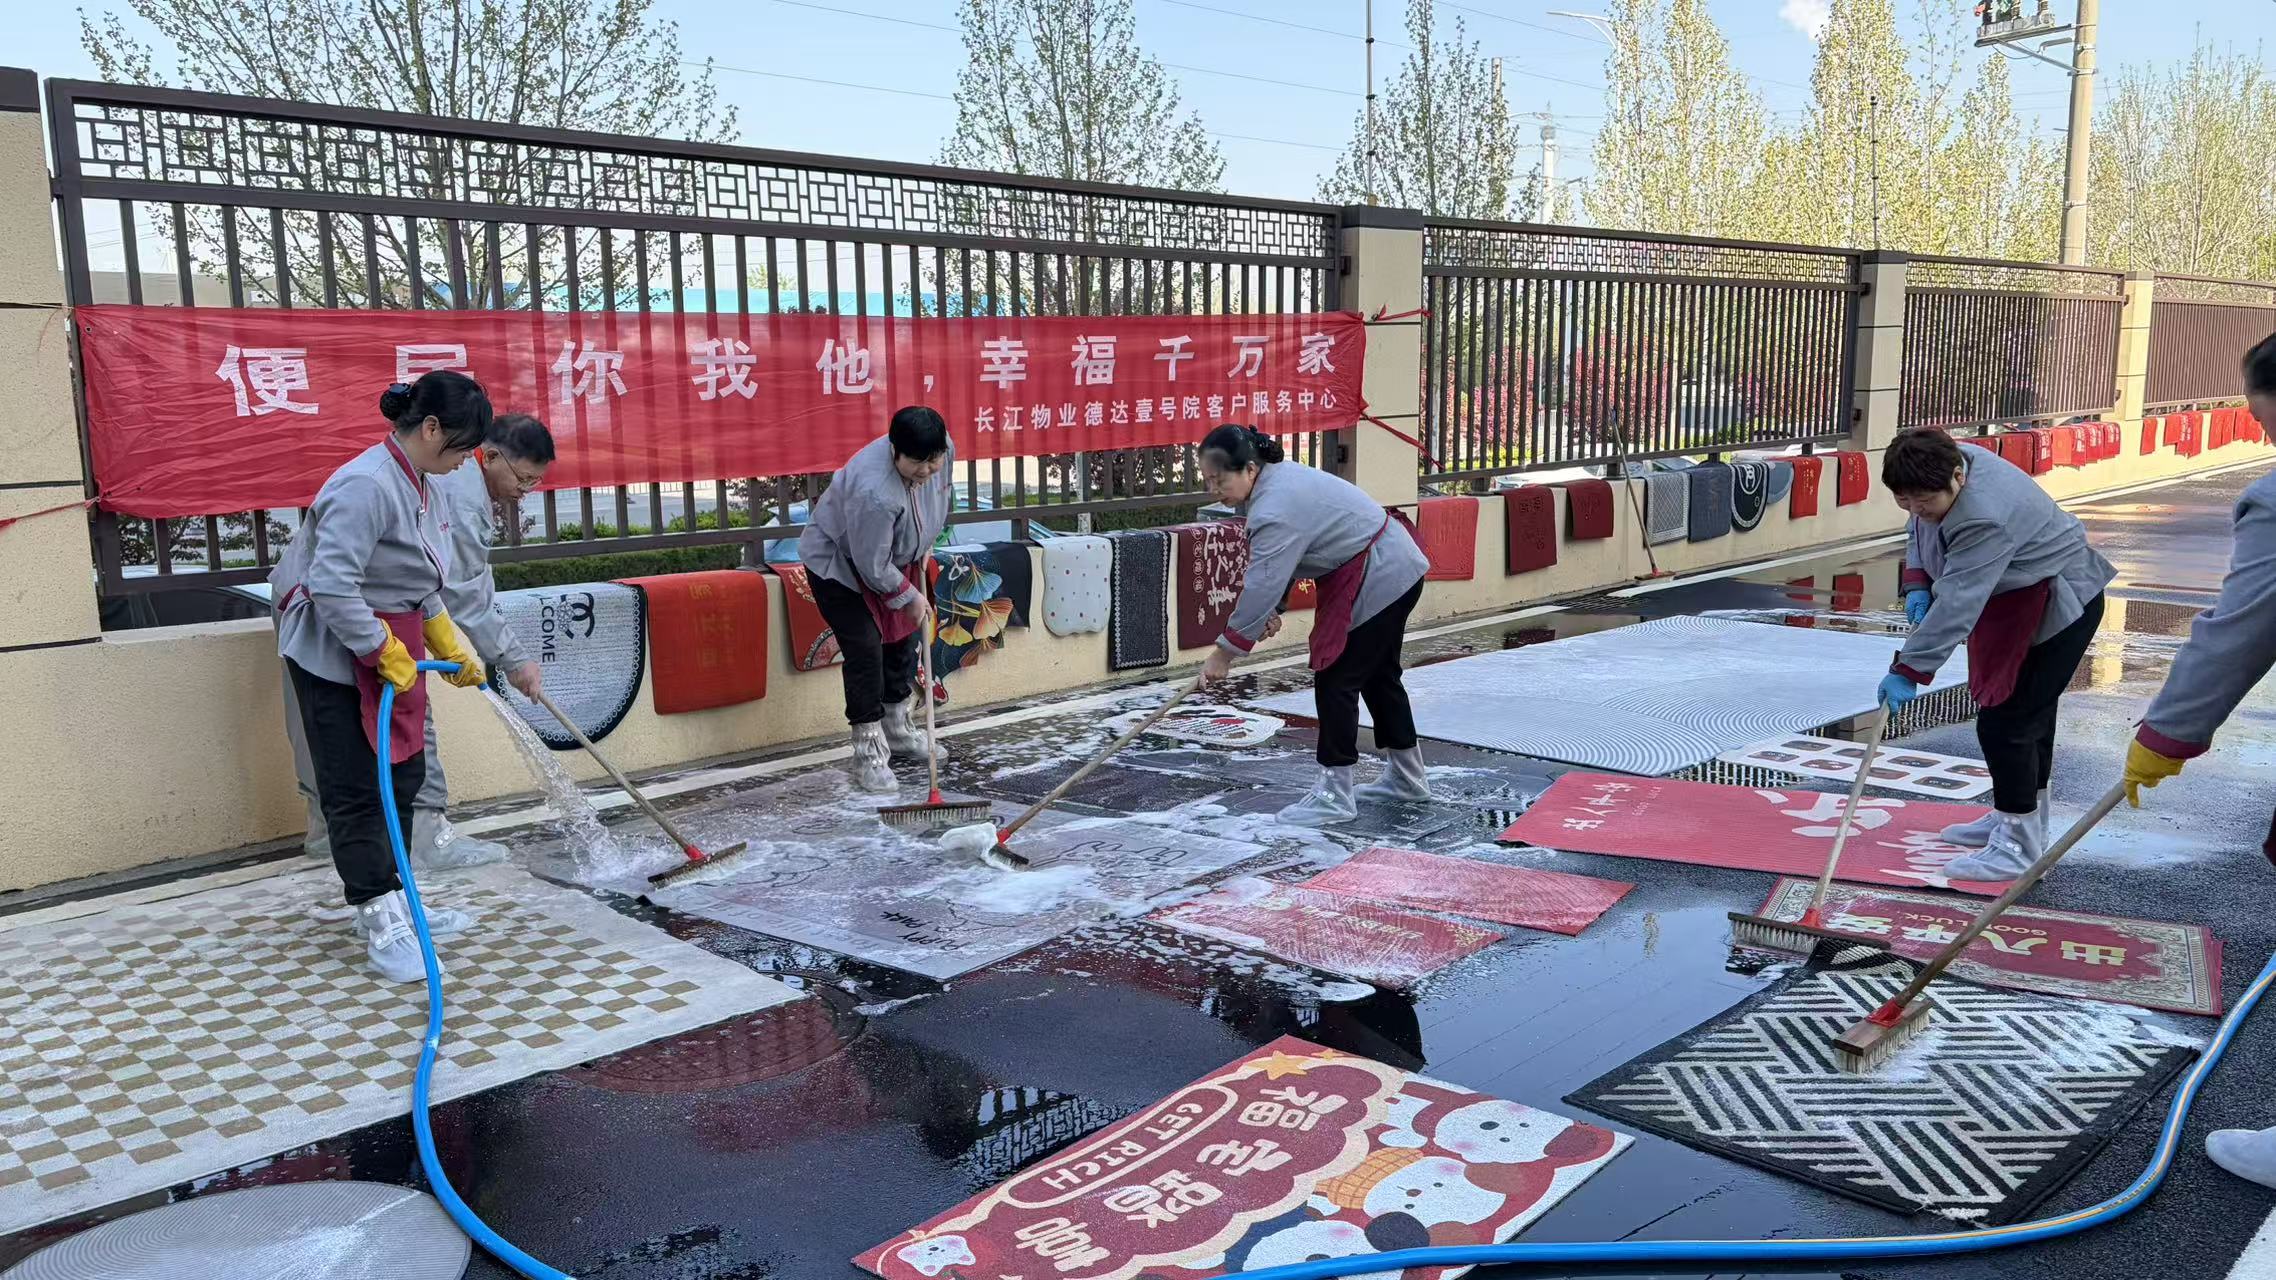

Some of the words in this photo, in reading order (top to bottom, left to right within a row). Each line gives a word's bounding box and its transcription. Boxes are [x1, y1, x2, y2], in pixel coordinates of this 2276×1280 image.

[974, 387, 1337, 433] 长江物业德达壹号院客户服务中心
[537, 595, 556, 663] LCOME
[1904, 912, 1970, 928] LUCK
[1144, 1103, 1204, 1142] GET
[1013, 1085, 1349, 1272] 福宅踏喜
[1040, 1139, 1148, 1191] RICH
